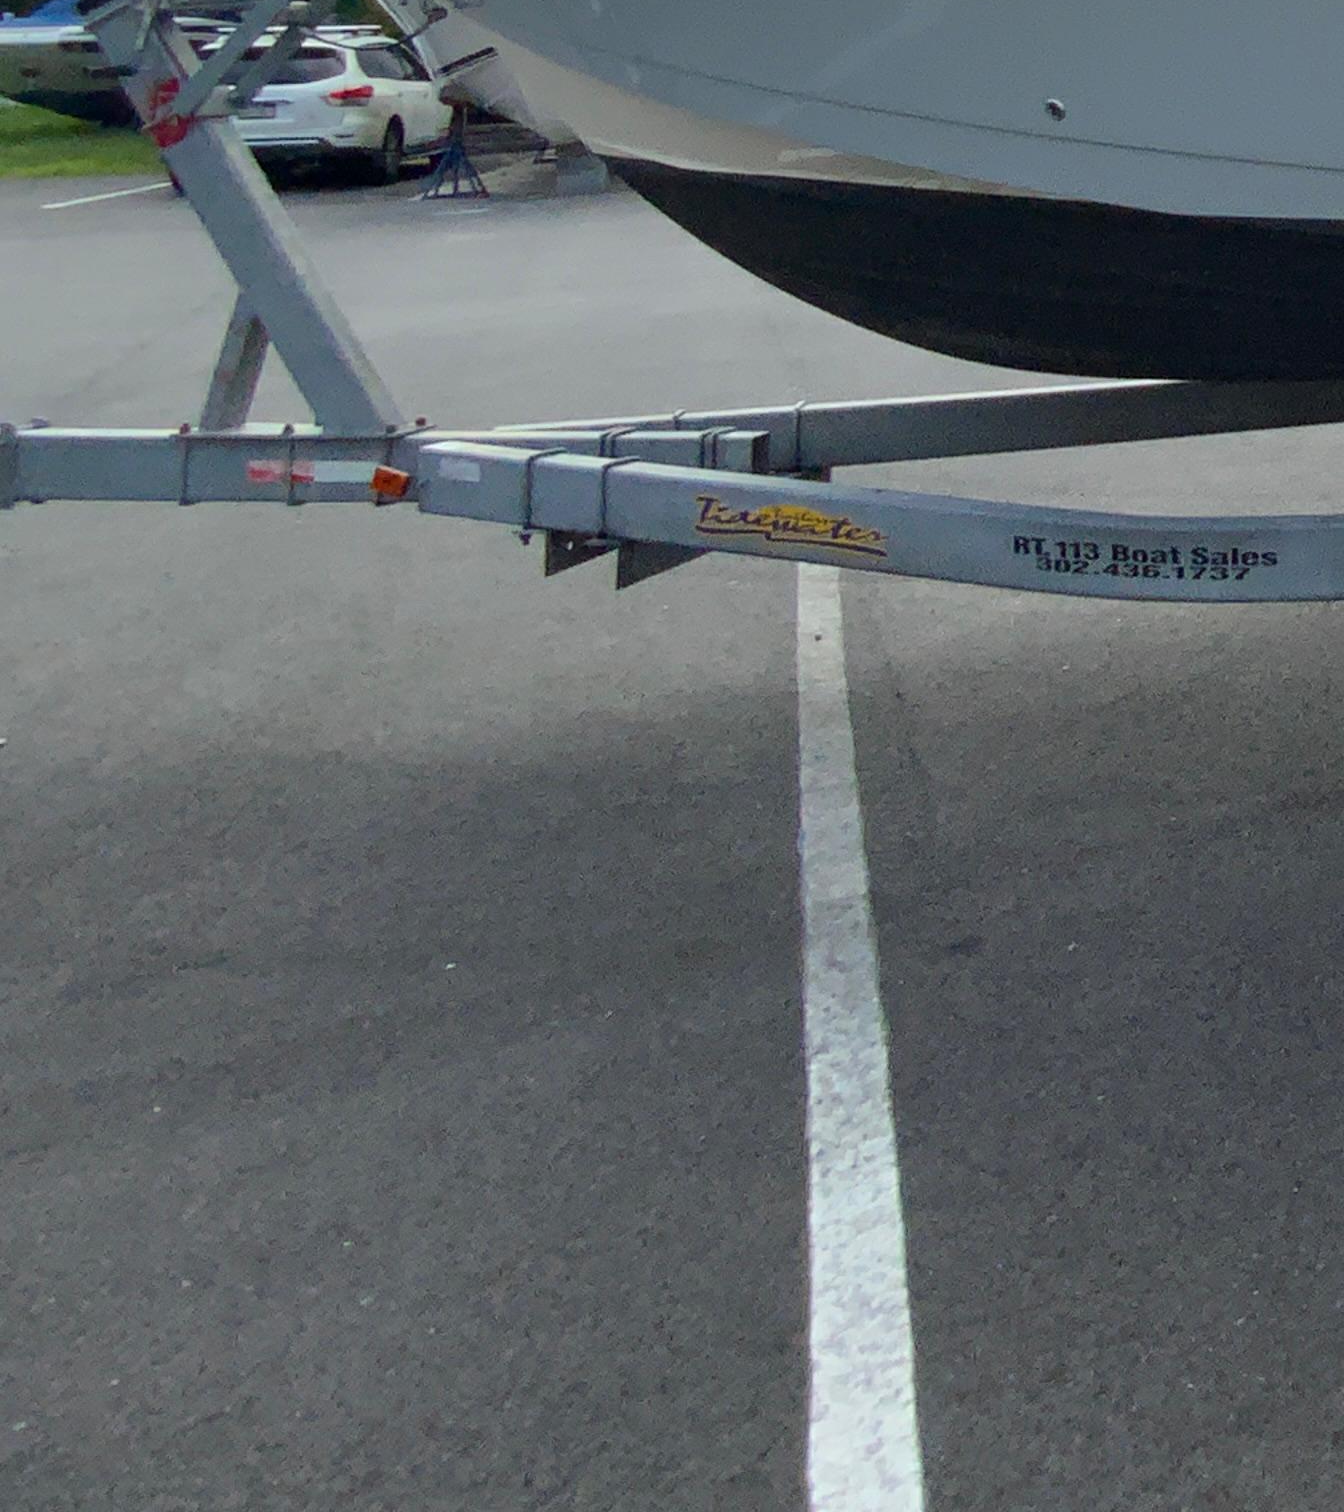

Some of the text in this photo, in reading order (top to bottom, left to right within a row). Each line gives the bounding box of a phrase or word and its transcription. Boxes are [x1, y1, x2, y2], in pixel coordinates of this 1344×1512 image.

[1055, 539, 1100, 561] 113
[1111, 544, 1182, 566] Boat
[1191, 546, 1279, 567] Sales
[1036, 556, 1252, 581] 302.436.1737
